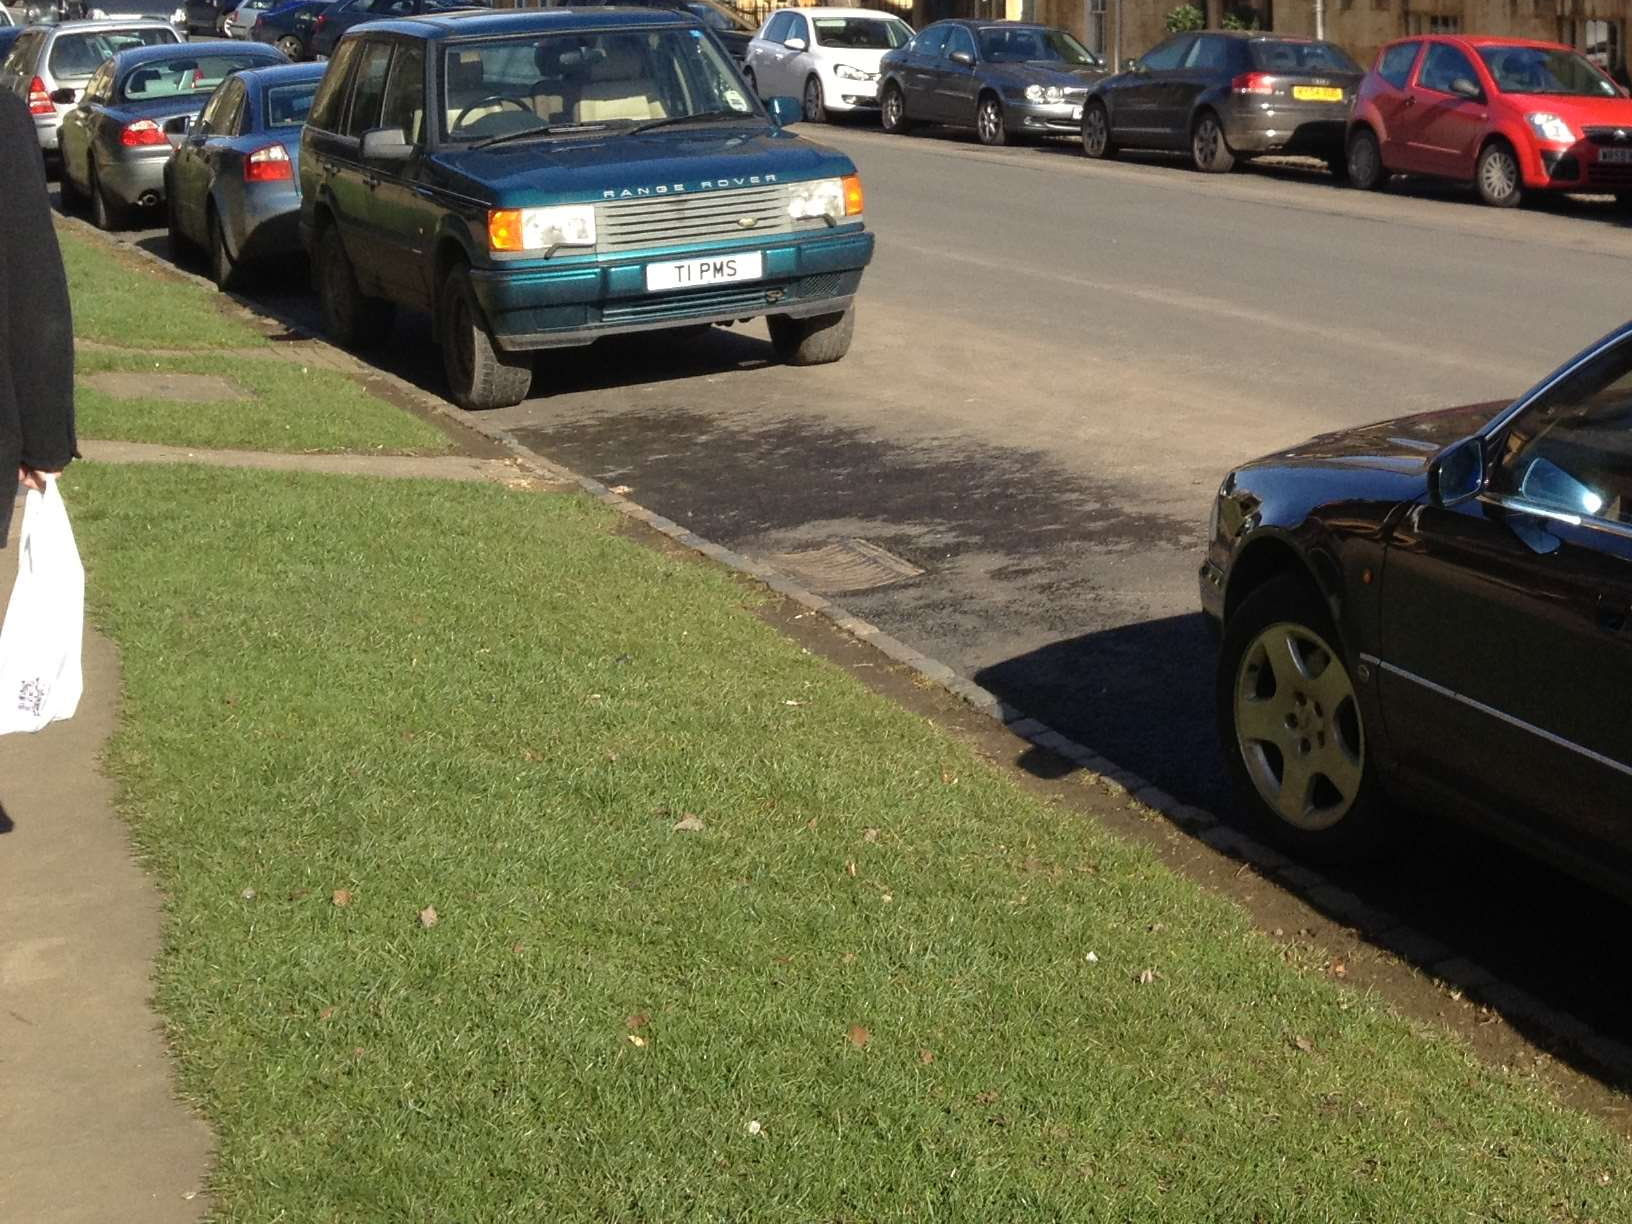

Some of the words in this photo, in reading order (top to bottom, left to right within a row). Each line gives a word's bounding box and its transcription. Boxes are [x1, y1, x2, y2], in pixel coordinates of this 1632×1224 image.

[603, 183, 685, 198] RANGE
[701, 174, 777, 189] ROVER
[700, 259, 737, 280] PMS
